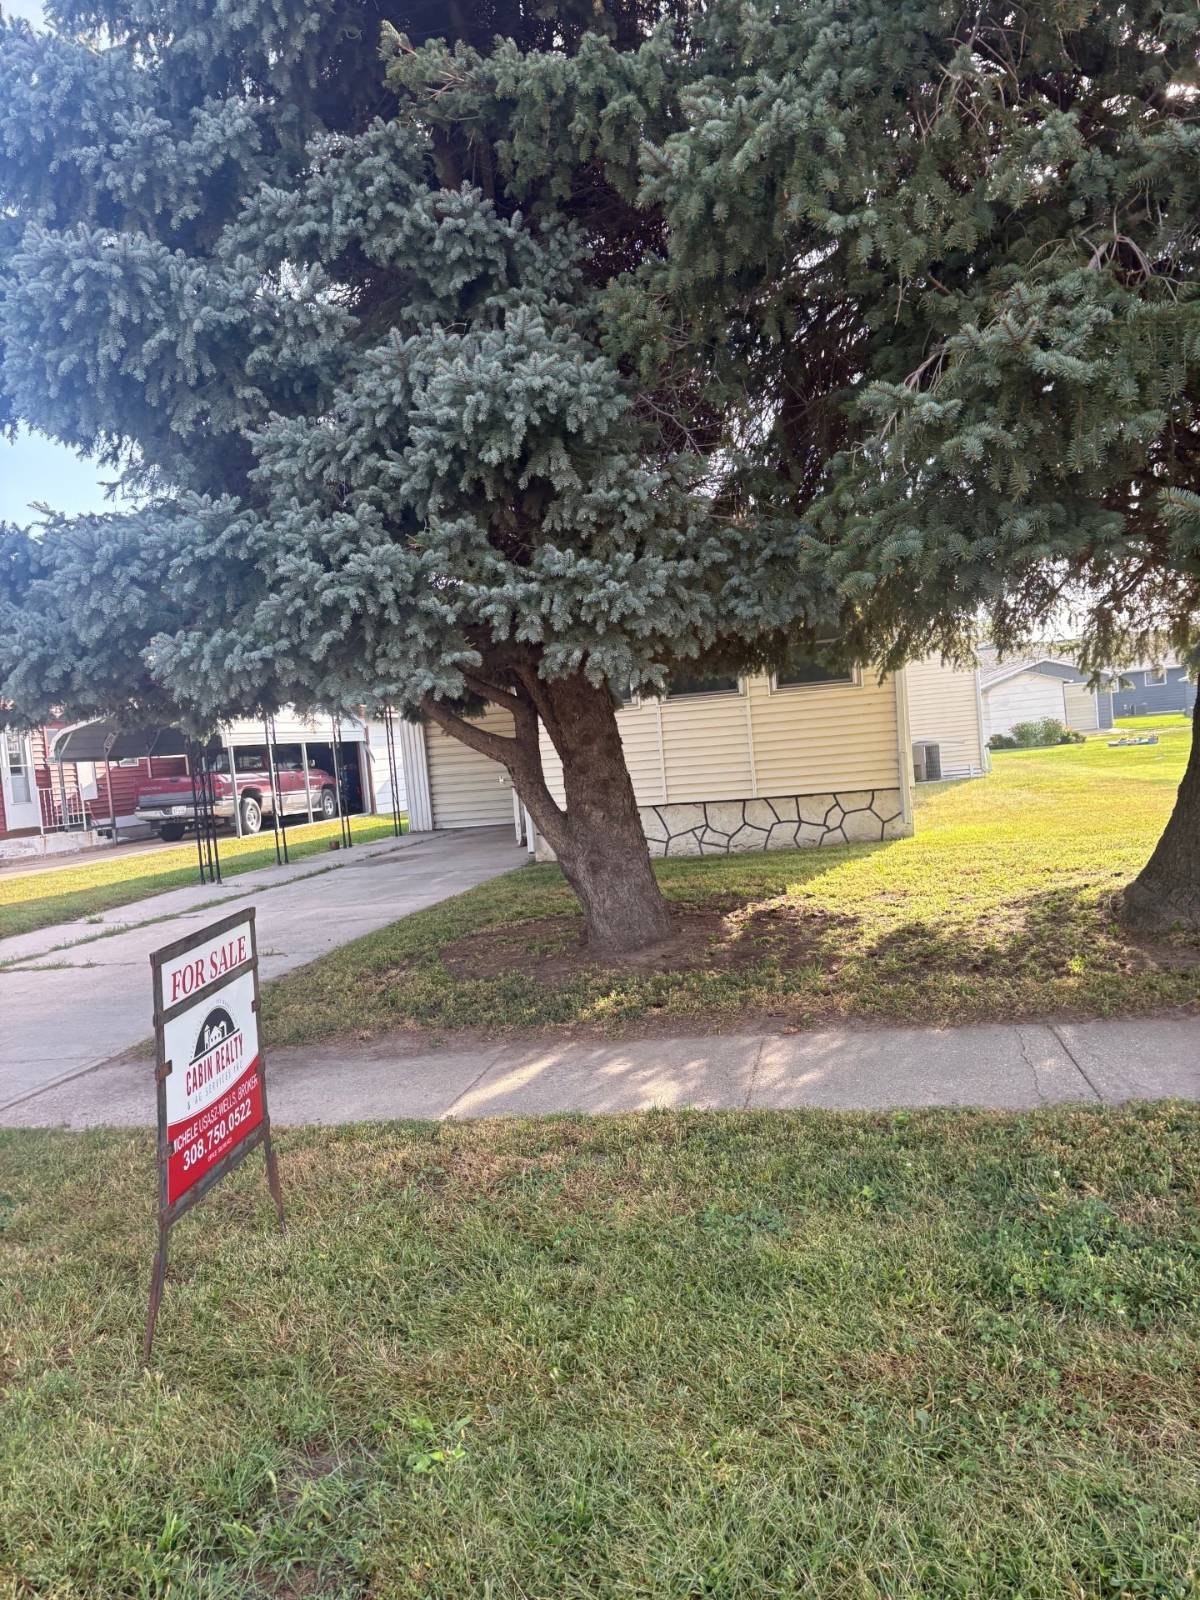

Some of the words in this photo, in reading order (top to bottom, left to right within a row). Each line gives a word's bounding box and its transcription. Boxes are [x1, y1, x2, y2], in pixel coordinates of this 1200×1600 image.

[170, 959, 206, 1002] FOR
[210, 935, 247, 979] SALE
[186, 1056, 213, 1096] CABIN
[216, 1033, 243, 1075] REALTY
[237, 1073, 258, 1101] BROKER
[183, 1098, 252, 1171] 308.750.0522
